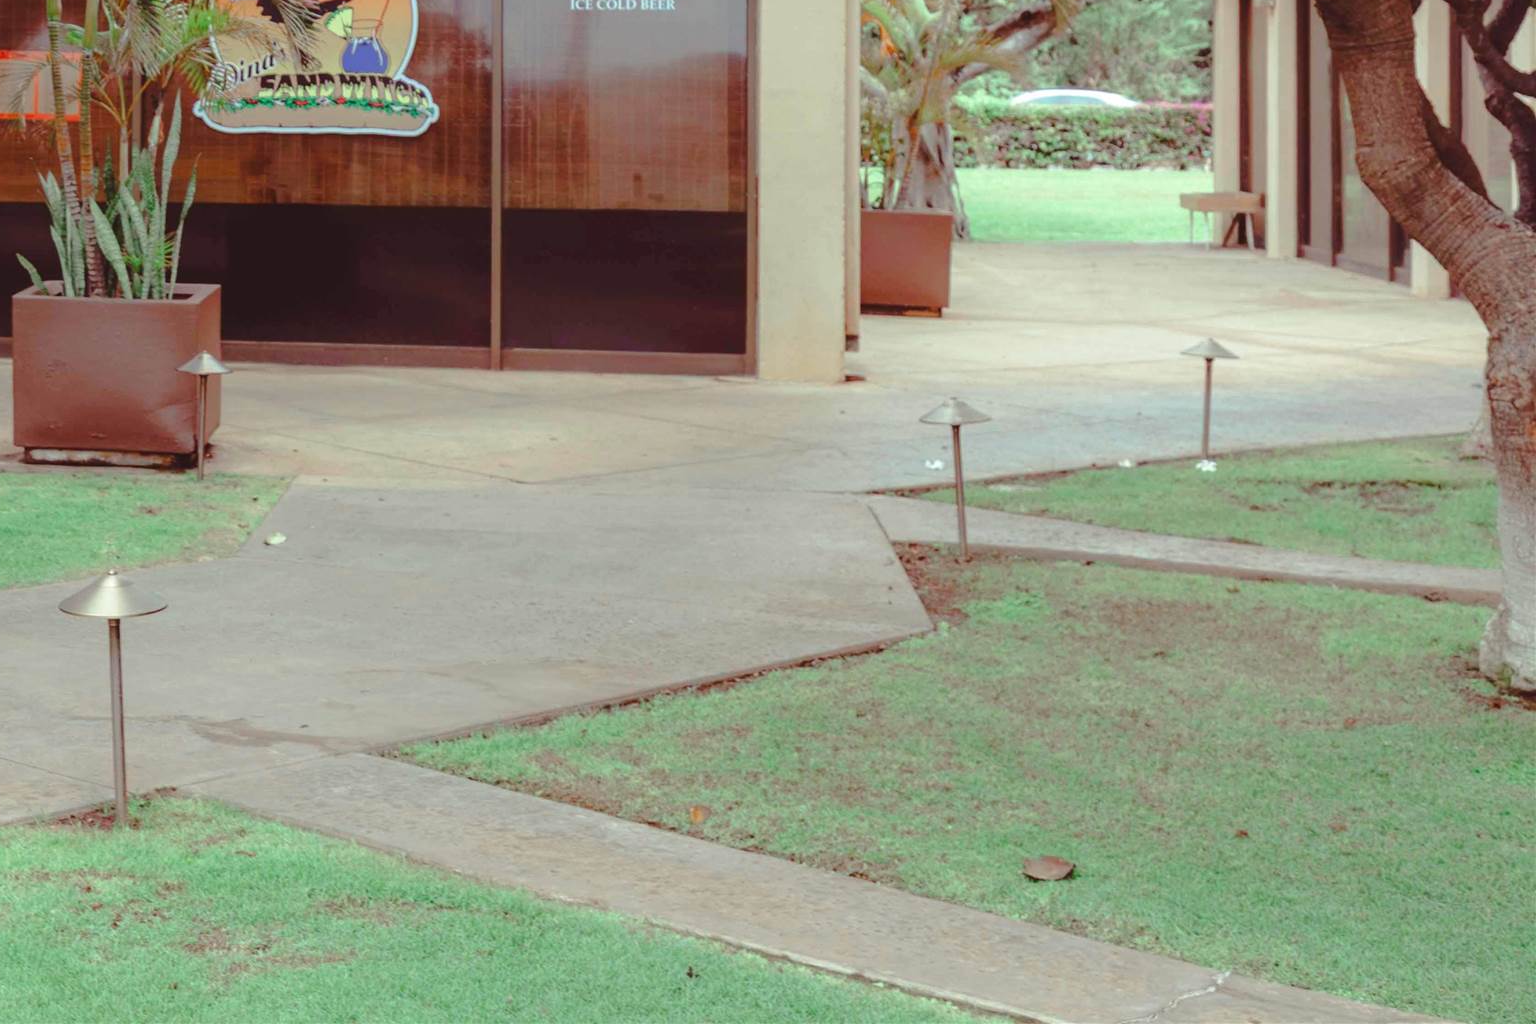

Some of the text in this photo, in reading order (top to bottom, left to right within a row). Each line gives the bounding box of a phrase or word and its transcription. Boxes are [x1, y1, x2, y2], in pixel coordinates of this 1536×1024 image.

[570, 0, 676, 11] ICE COLD BEER
[259, 74, 429, 109] SAND WITCH
